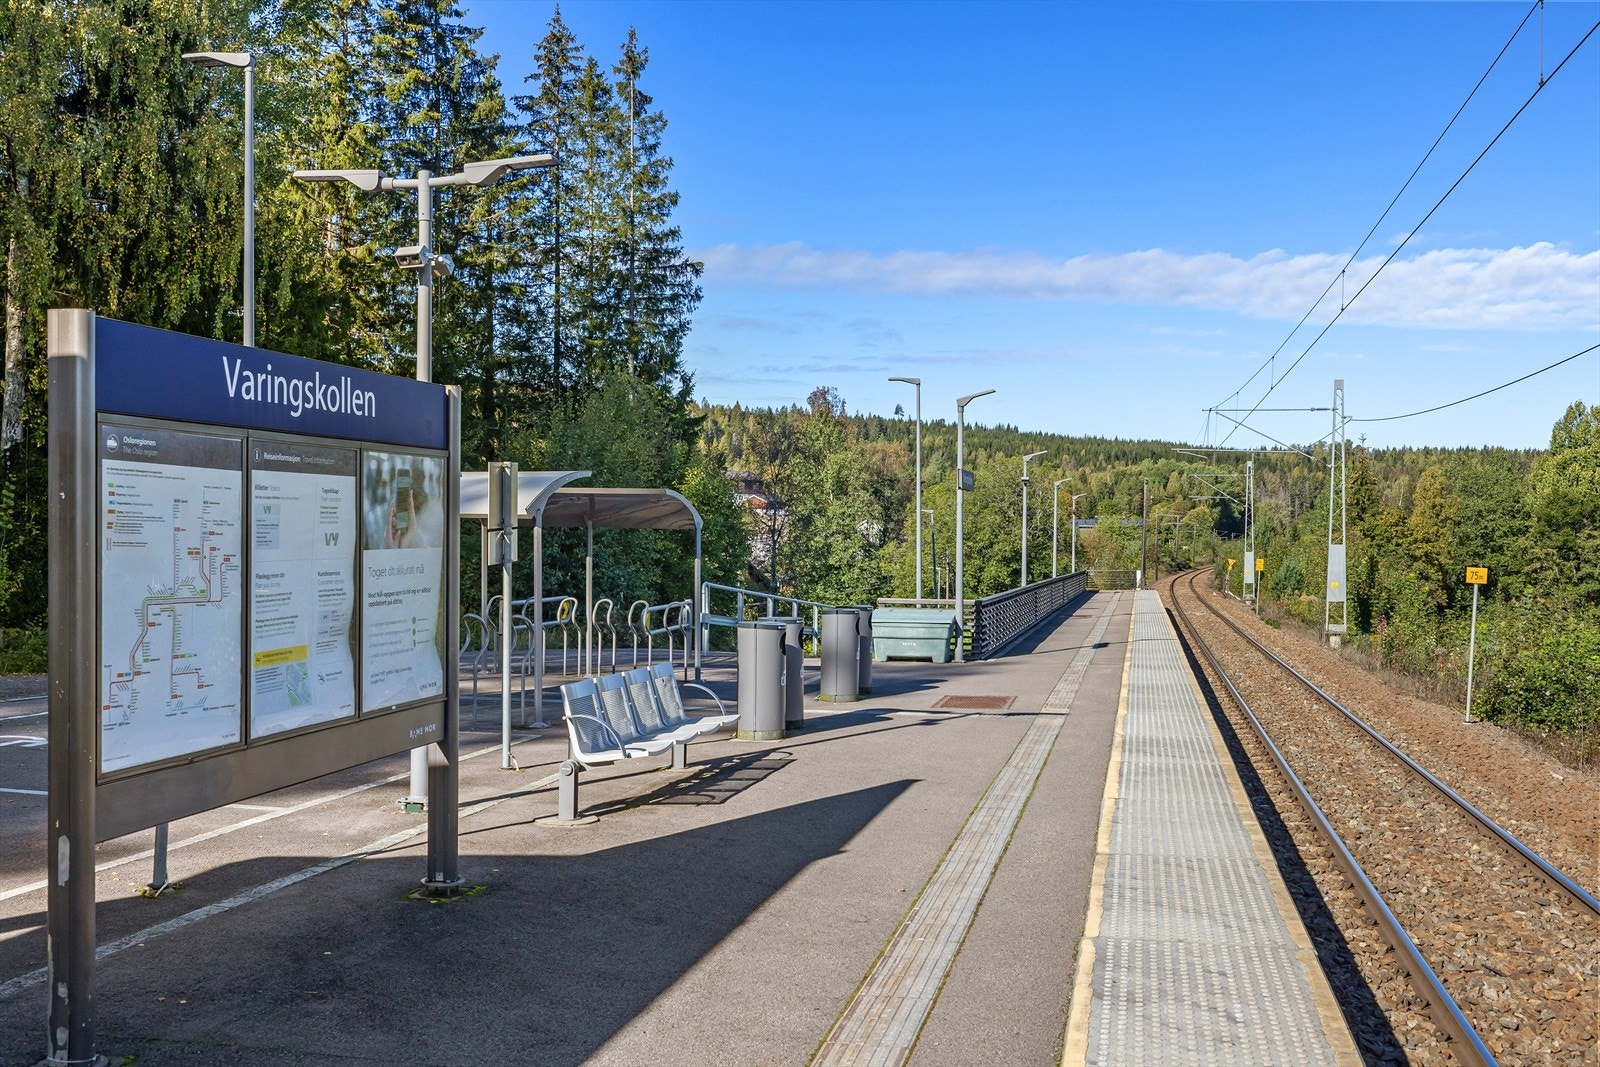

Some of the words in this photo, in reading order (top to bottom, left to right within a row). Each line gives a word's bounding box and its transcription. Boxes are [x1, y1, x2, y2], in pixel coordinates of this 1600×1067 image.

[222, 356, 376, 418] Varingskollen
[123, 436, 156, 447] Osloregionen
[122, 446, 131, 454] The
[132, 446, 143, 455] Oslo
[143, 448, 159, 458] region
[263, 452, 301, 463] Reiseinformasjon
[367, 566, 387, 581] Toget
[415, 563, 425, 575] nå
[424, 723, 436, 733] NOR
